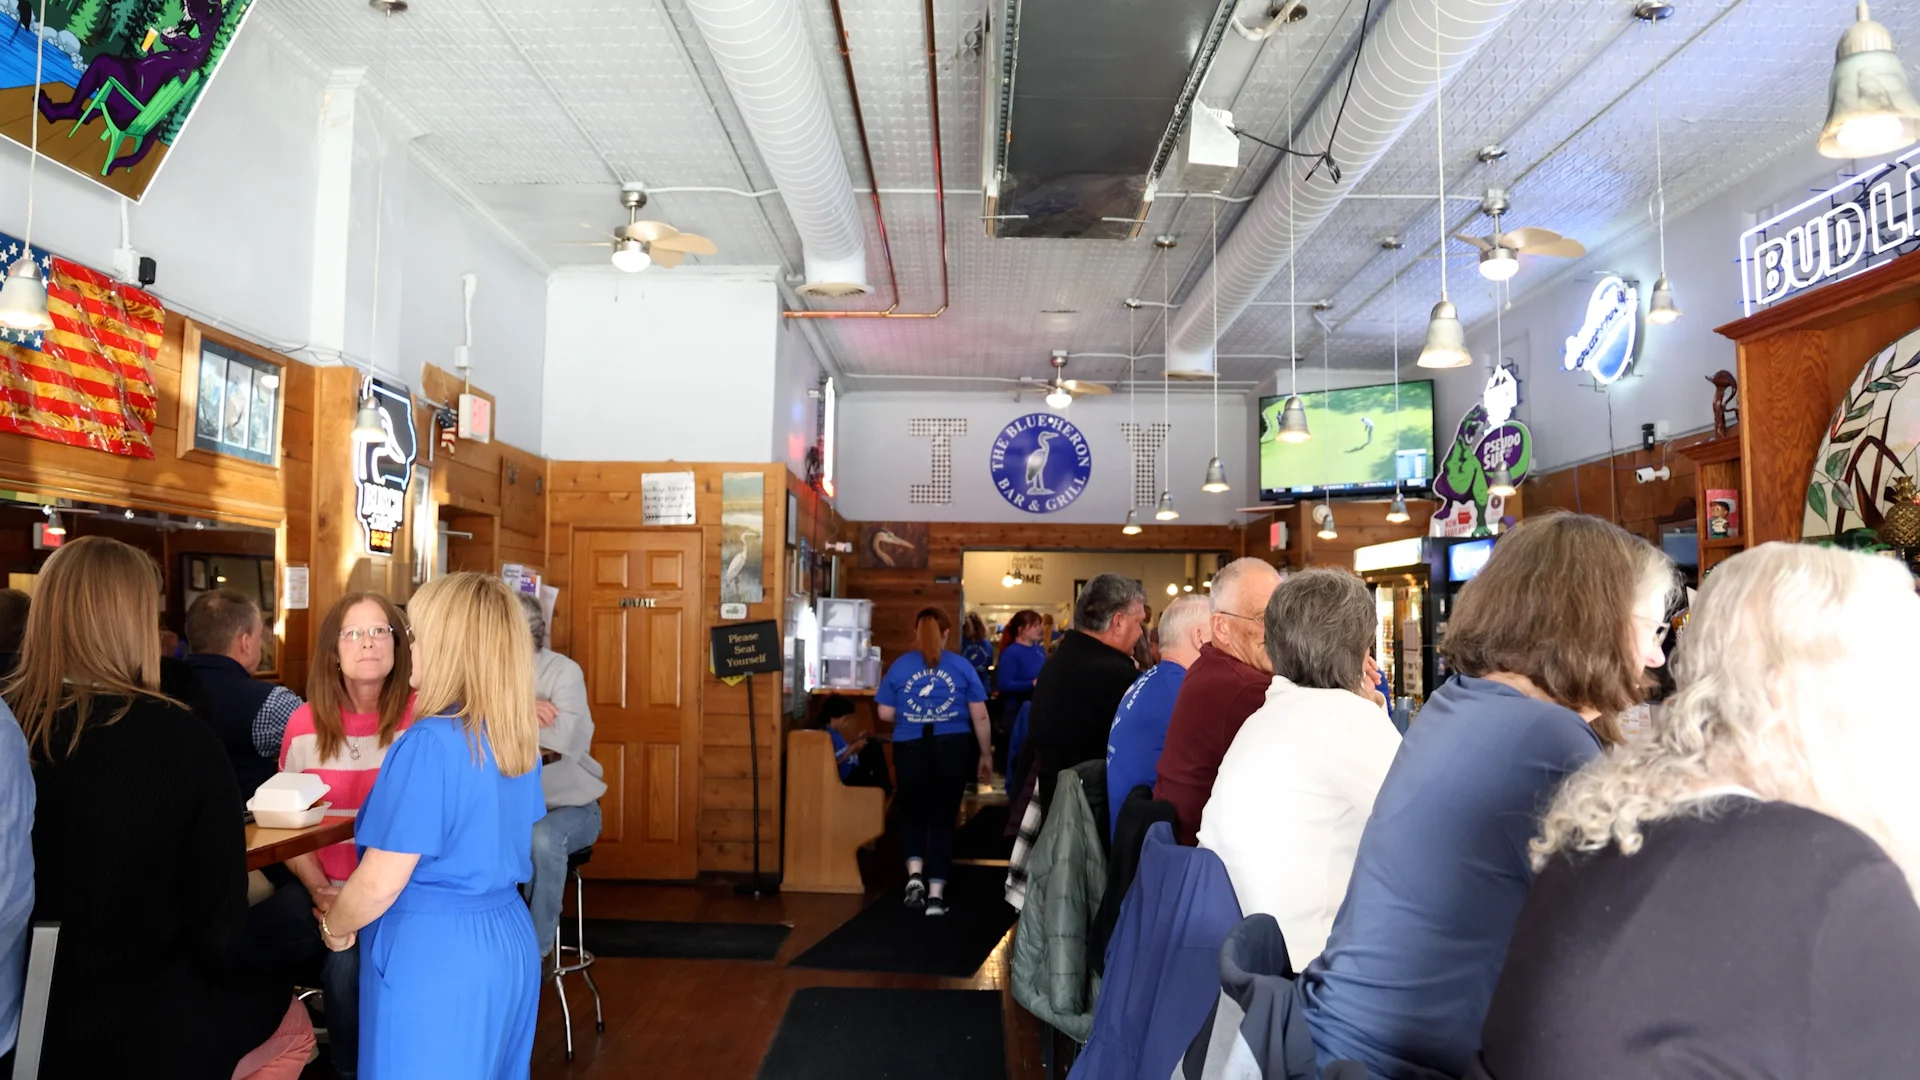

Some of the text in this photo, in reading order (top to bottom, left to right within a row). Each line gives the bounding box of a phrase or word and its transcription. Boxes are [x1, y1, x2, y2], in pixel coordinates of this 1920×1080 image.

[992, 415, 1090, 472] THE BLUE HERON
[1483, 433, 1521, 455] PSEUDO
[998, 476, 1087, 511] BAR & GRILL
[620, 598, 656, 608] PRIVATE
[728, 632, 759, 643] Please
[734, 644, 756, 655] Seat
[726, 653, 767, 667] Yourself
[912, 668, 934, 681] BLUE
[906, 698, 922, 713] BAR
[935, 696, 956, 714] GRILL
